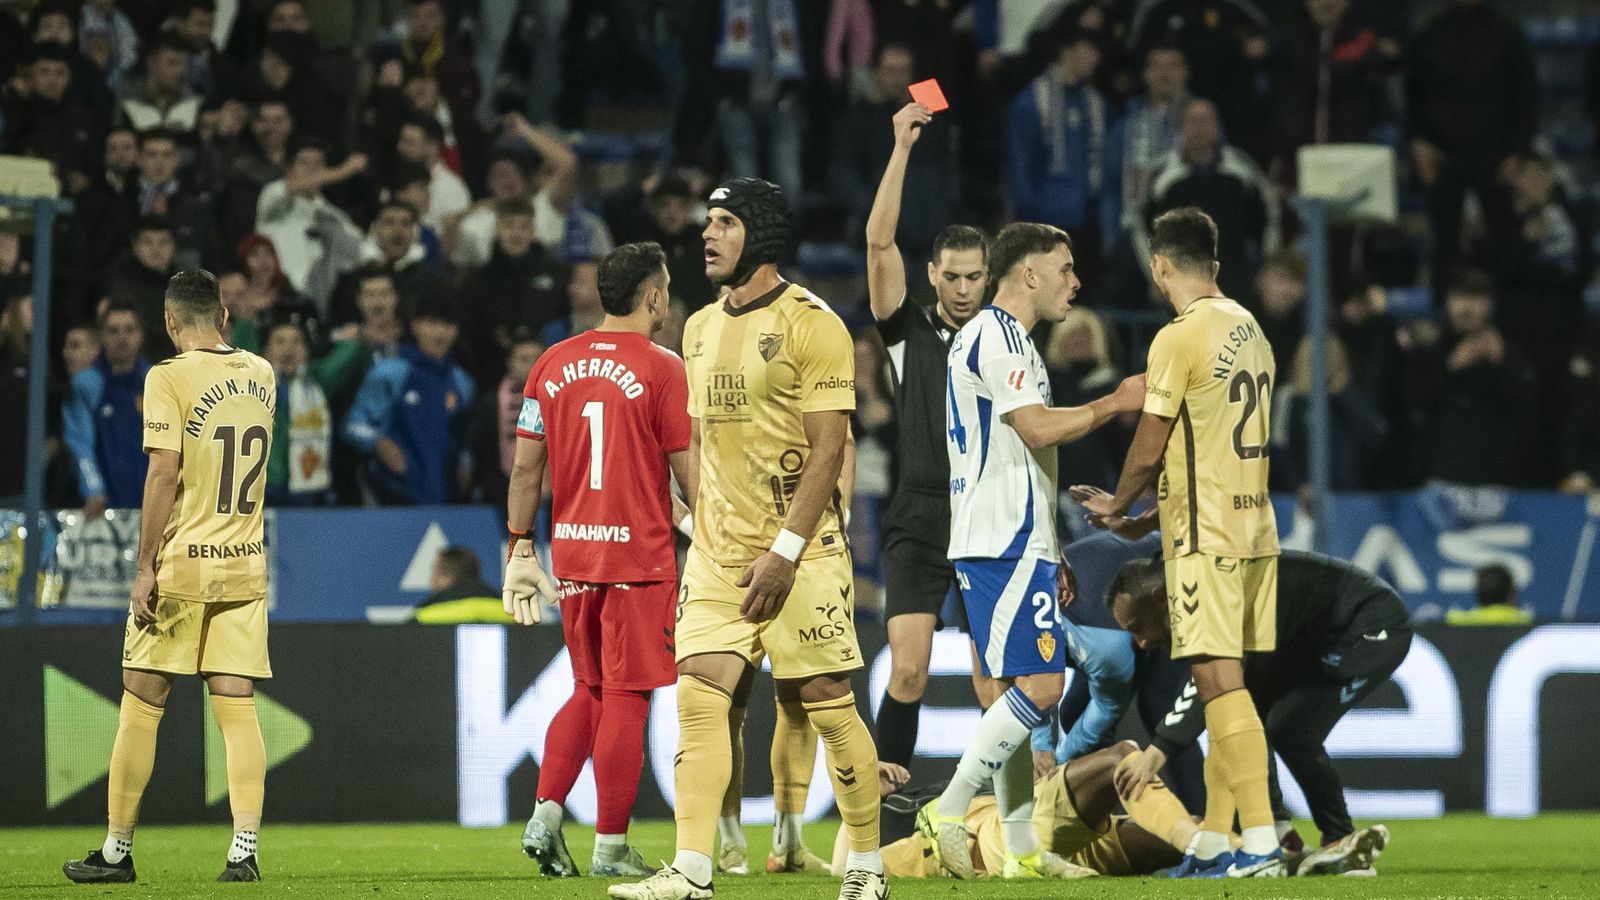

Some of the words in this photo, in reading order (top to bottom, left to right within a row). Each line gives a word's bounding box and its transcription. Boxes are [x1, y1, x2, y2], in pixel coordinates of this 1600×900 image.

[544, 380, 564, 398] A.
[562, 358, 644, 399] HERRERO
[713, 365, 747, 389] má
[185, 384, 225, 438] MANU
[225, 378, 244, 396] N.
[707, 386, 750, 412] laga
[581, 401, 604, 490] 1
[211, 425, 269, 516] 12
[554, 523, 631, 542] BENAHAVIS
[799, 621, 845, 643] MGS
